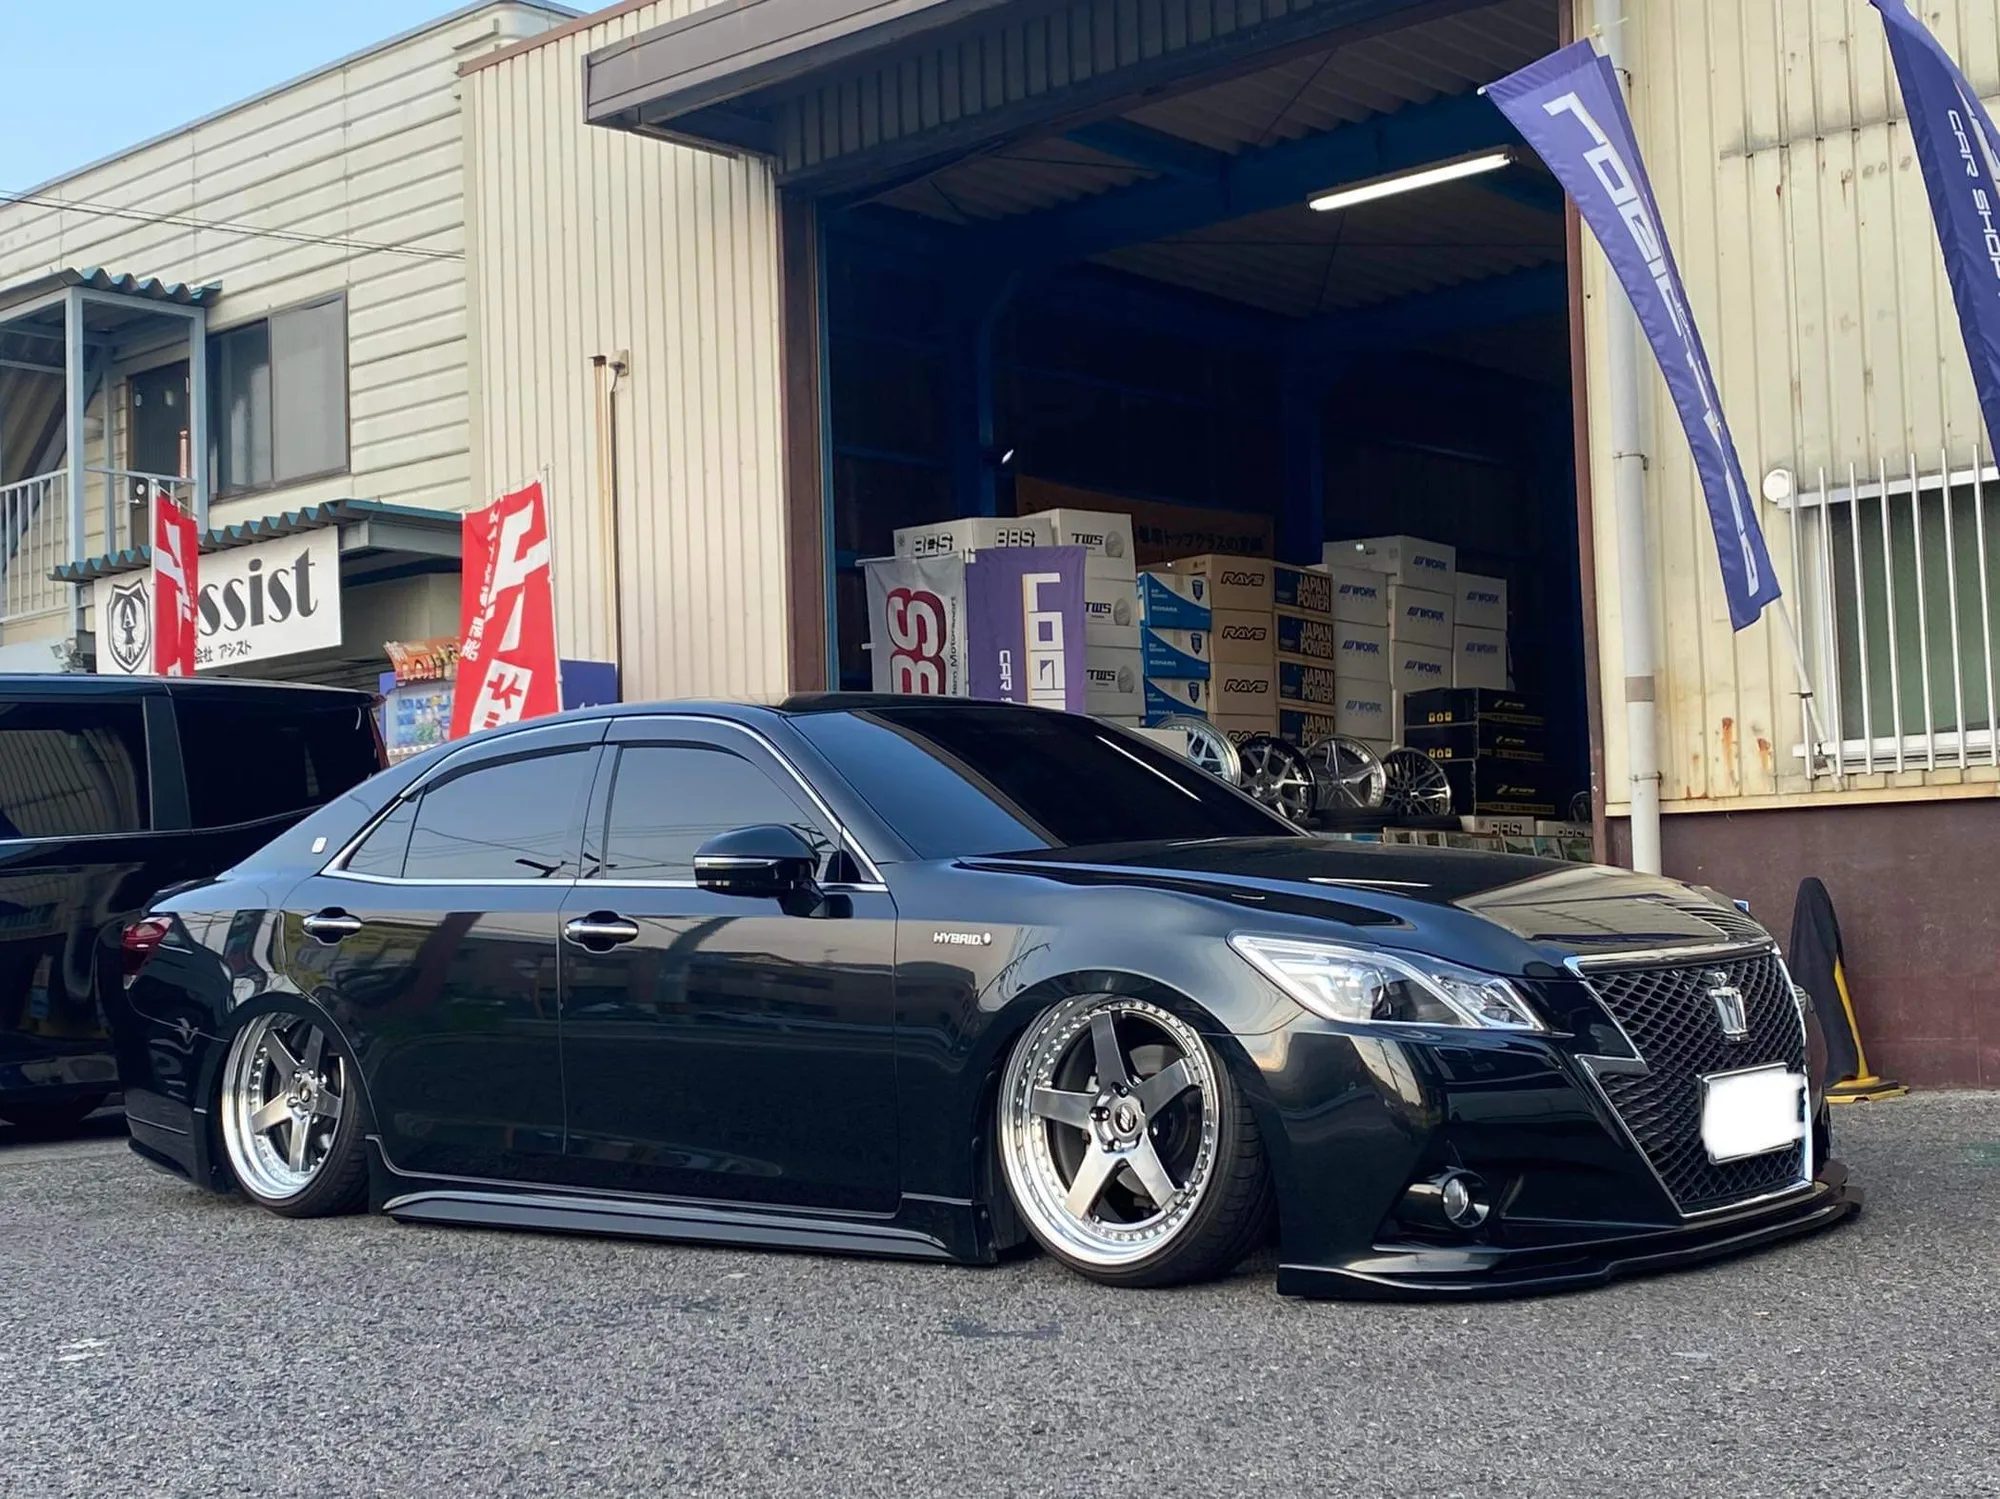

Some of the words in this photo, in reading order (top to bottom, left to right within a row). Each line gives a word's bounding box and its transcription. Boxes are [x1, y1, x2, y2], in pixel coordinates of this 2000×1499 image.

[1947, 109, 1979, 178] CAR
[994, 527, 1036, 548] BBS
[1071, 532, 1104, 546] TWS
[1425, 557, 1448, 571] WORK
[1221, 571, 1265, 587] RAYS
[1297, 574, 1331, 598] JAPAN
[197, 548, 318, 636] ssist
[1352, 585, 1377, 598] WORK
[1084, 601, 1112, 614] TWS
[1297, 587, 1331, 613] POWER
[1420, 608, 1445, 621] WORK
[1222, 625, 1267, 640] RAYS
[1301, 620, 1333, 643] JAPAN
[219, 640, 252, 660] アシスト
[1301, 634, 1333, 659] POWER
[1355, 641, 1379, 654] WORK
[999, 650, 1012, 691] CAR
[1086, 669, 1116, 681] TWS
[1417, 661, 1443, 675] WORK
[1224, 678, 1269, 693] RAYS
[1302, 666, 1334, 690] JAPAN
[1302, 681, 1334, 704] POWER
[1358, 701, 1382, 713] WORK
[933, 932, 982, 946] HYBRID
